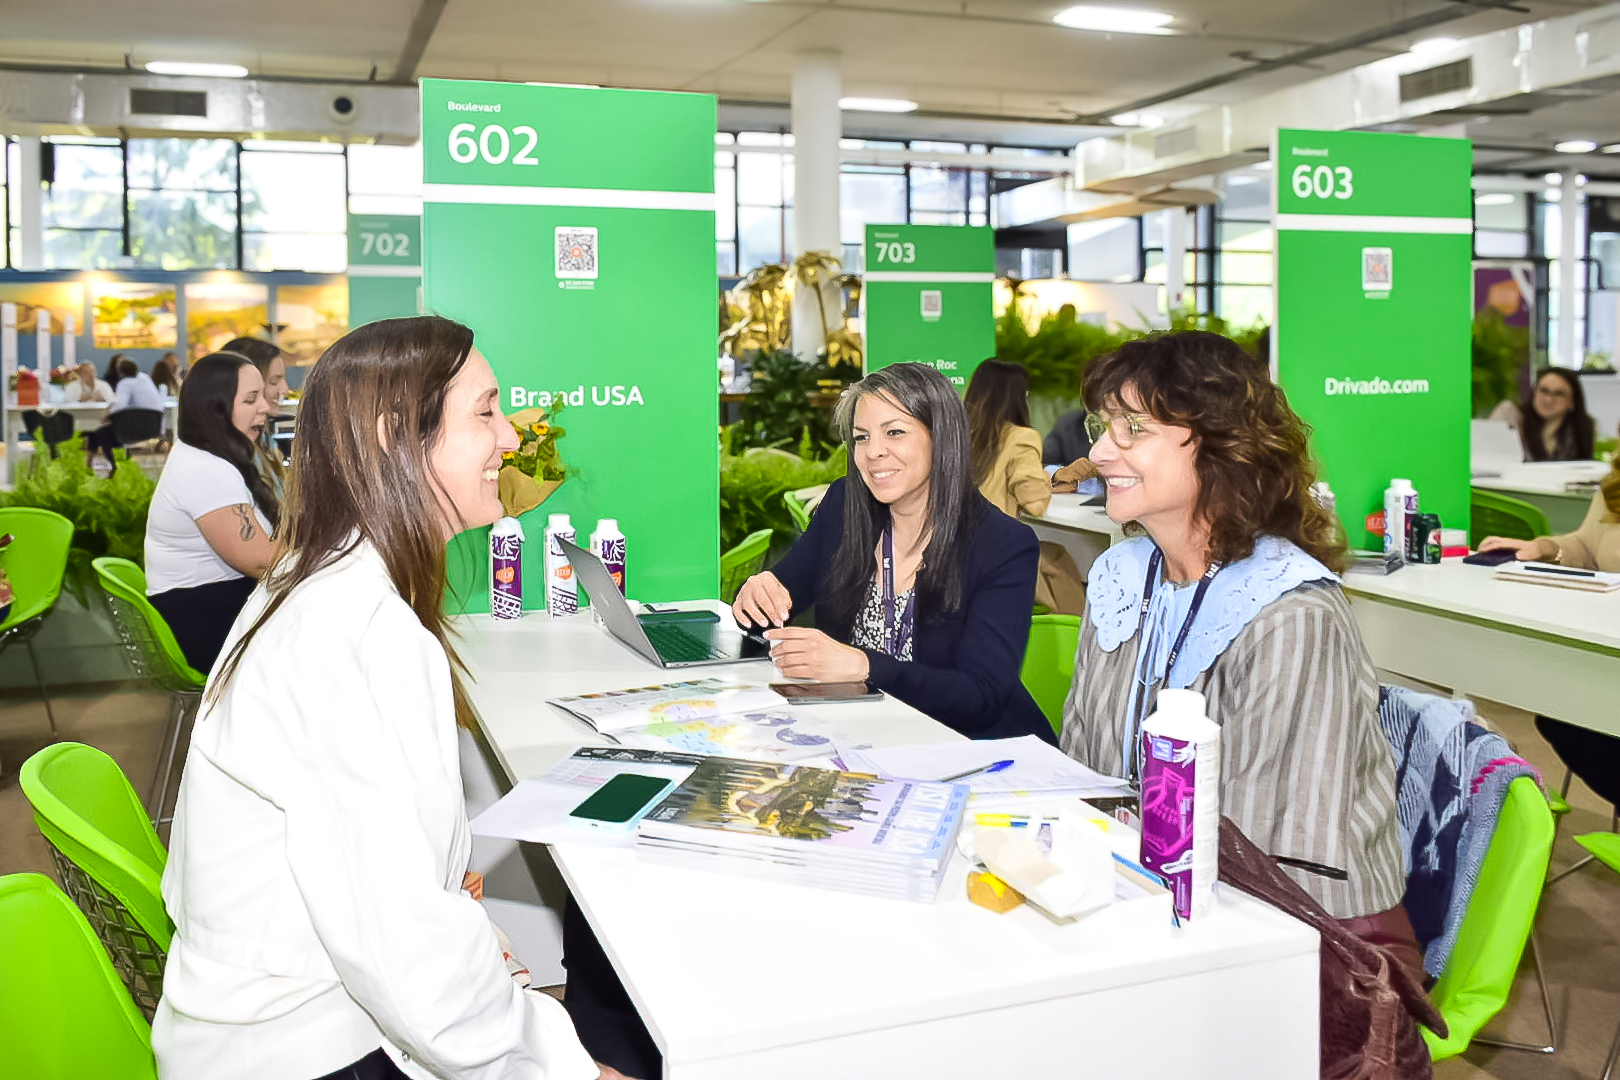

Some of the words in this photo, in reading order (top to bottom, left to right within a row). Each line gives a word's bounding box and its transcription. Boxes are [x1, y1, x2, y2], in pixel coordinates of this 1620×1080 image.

[447, 100, 502, 113] Boulevard
[448, 122, 539, 166] 602
[1291, 164, 1354, 200] 603
[360, 232, 410, 257] 702
[874, 242, 916, 264] 703
[591, 385, 646, 406] USA
[1324, 376, 1430, 396] Drivado.com
